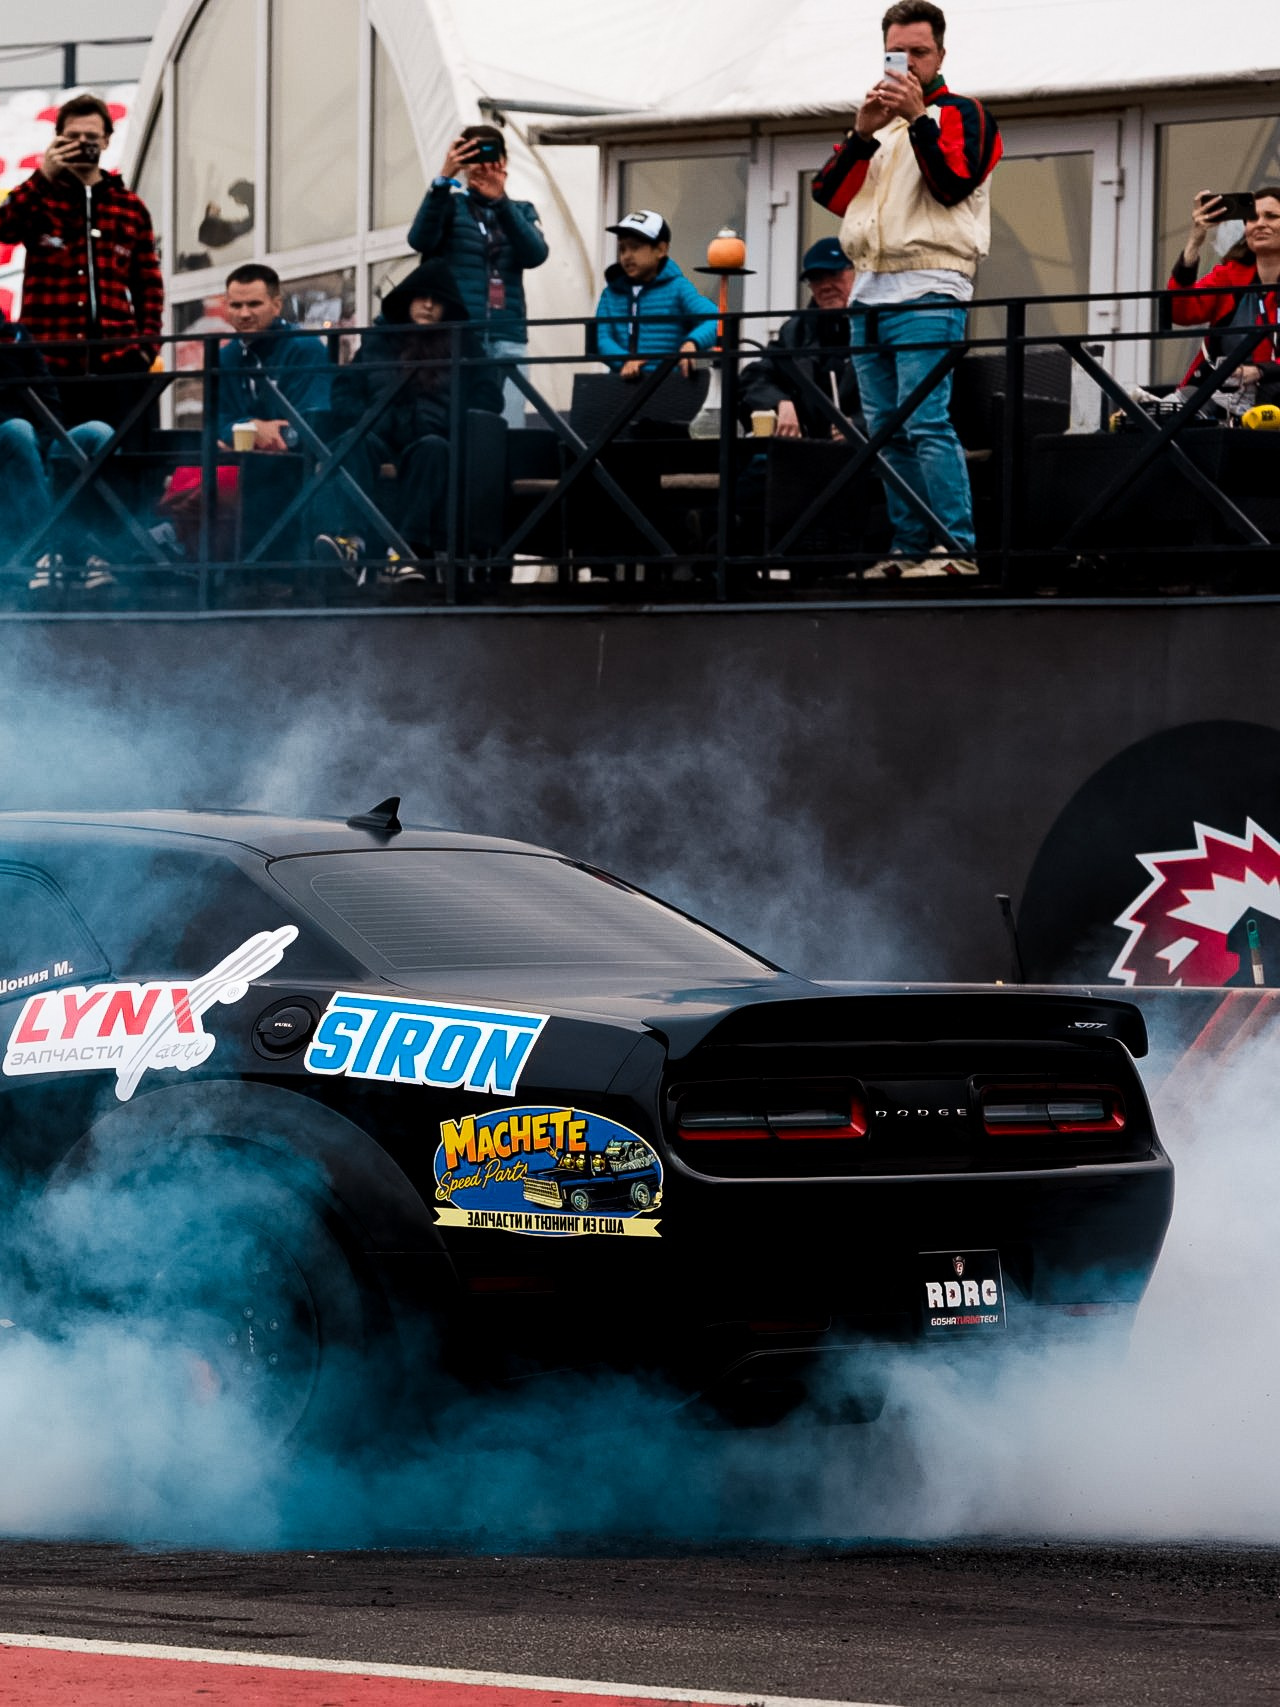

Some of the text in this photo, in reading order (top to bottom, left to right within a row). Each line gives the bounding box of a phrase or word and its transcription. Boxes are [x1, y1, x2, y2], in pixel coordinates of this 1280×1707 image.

[54, 961, 74, 977] М.
[15, 988, 196, 1044] LYNX
[10, 1045, 124, 1066] ЗАПЧАСТИ
[309, 996, 542, 1091] STRON
[875, 1108, 968, 1118] DODGE
[441, 1110, 587, 1170] MACHETE
[436, 1158, 528, 1200] Speed Parts
[467, 1211, 625, 1234] ЗАПЧАСТИ И ТЮНИНГ ИЗ США
[925, 1279, 998, 1308] RDRC
